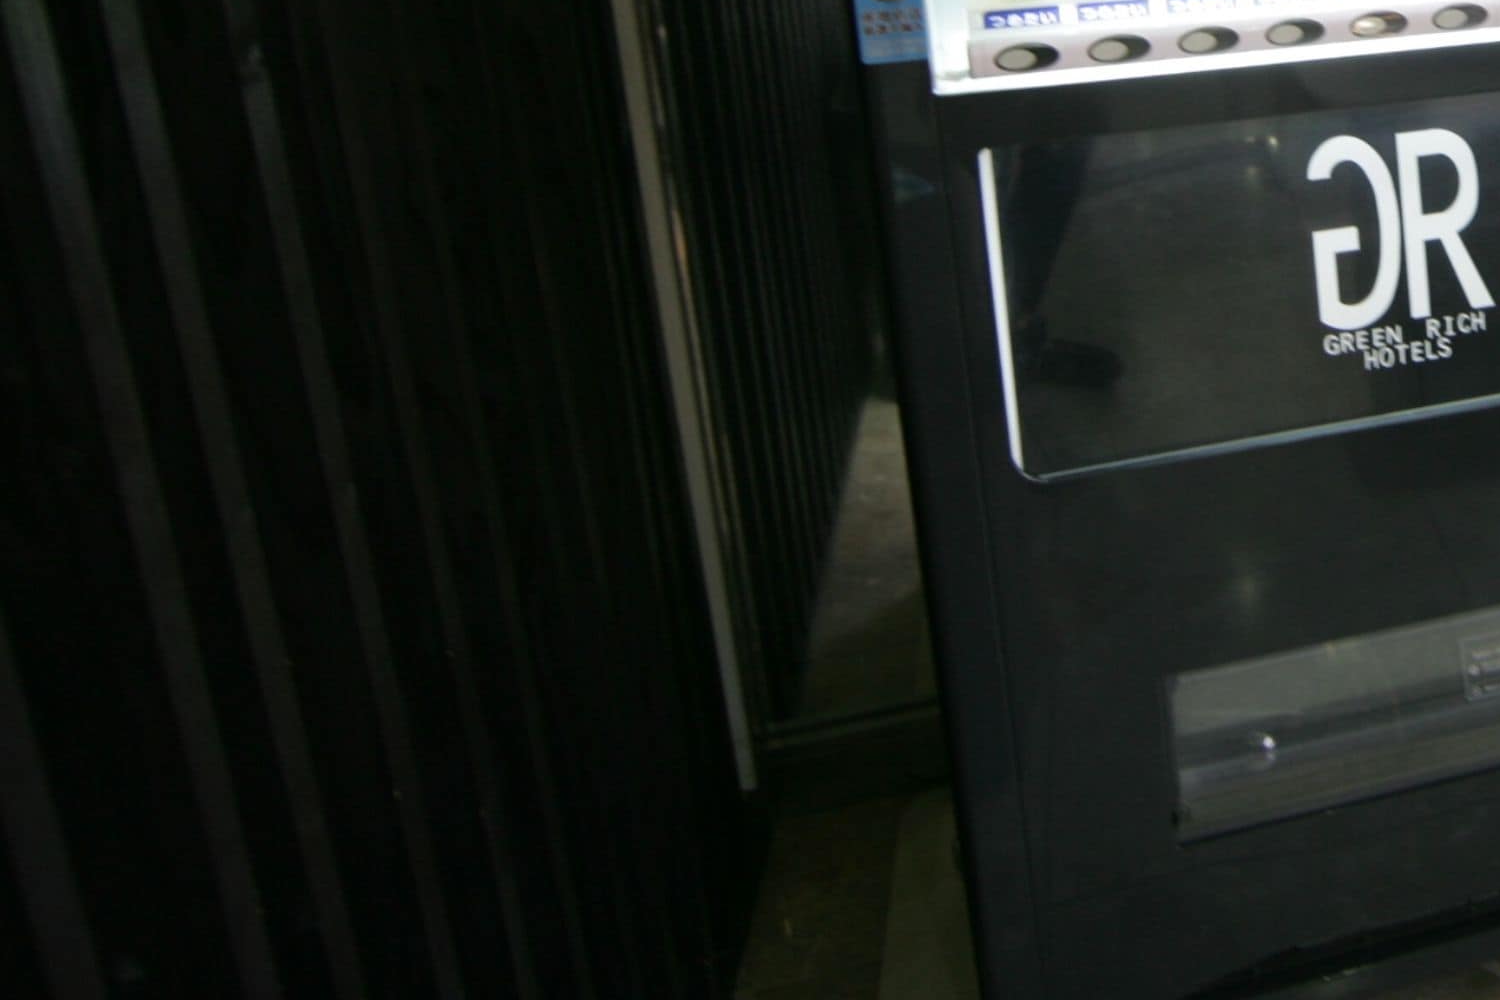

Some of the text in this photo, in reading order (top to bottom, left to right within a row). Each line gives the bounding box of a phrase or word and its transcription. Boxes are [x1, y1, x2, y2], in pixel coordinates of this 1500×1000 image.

[1323, 311, 1487, 356] GREEN RICH
[1363, 336, 1454, 371] HOTELS
